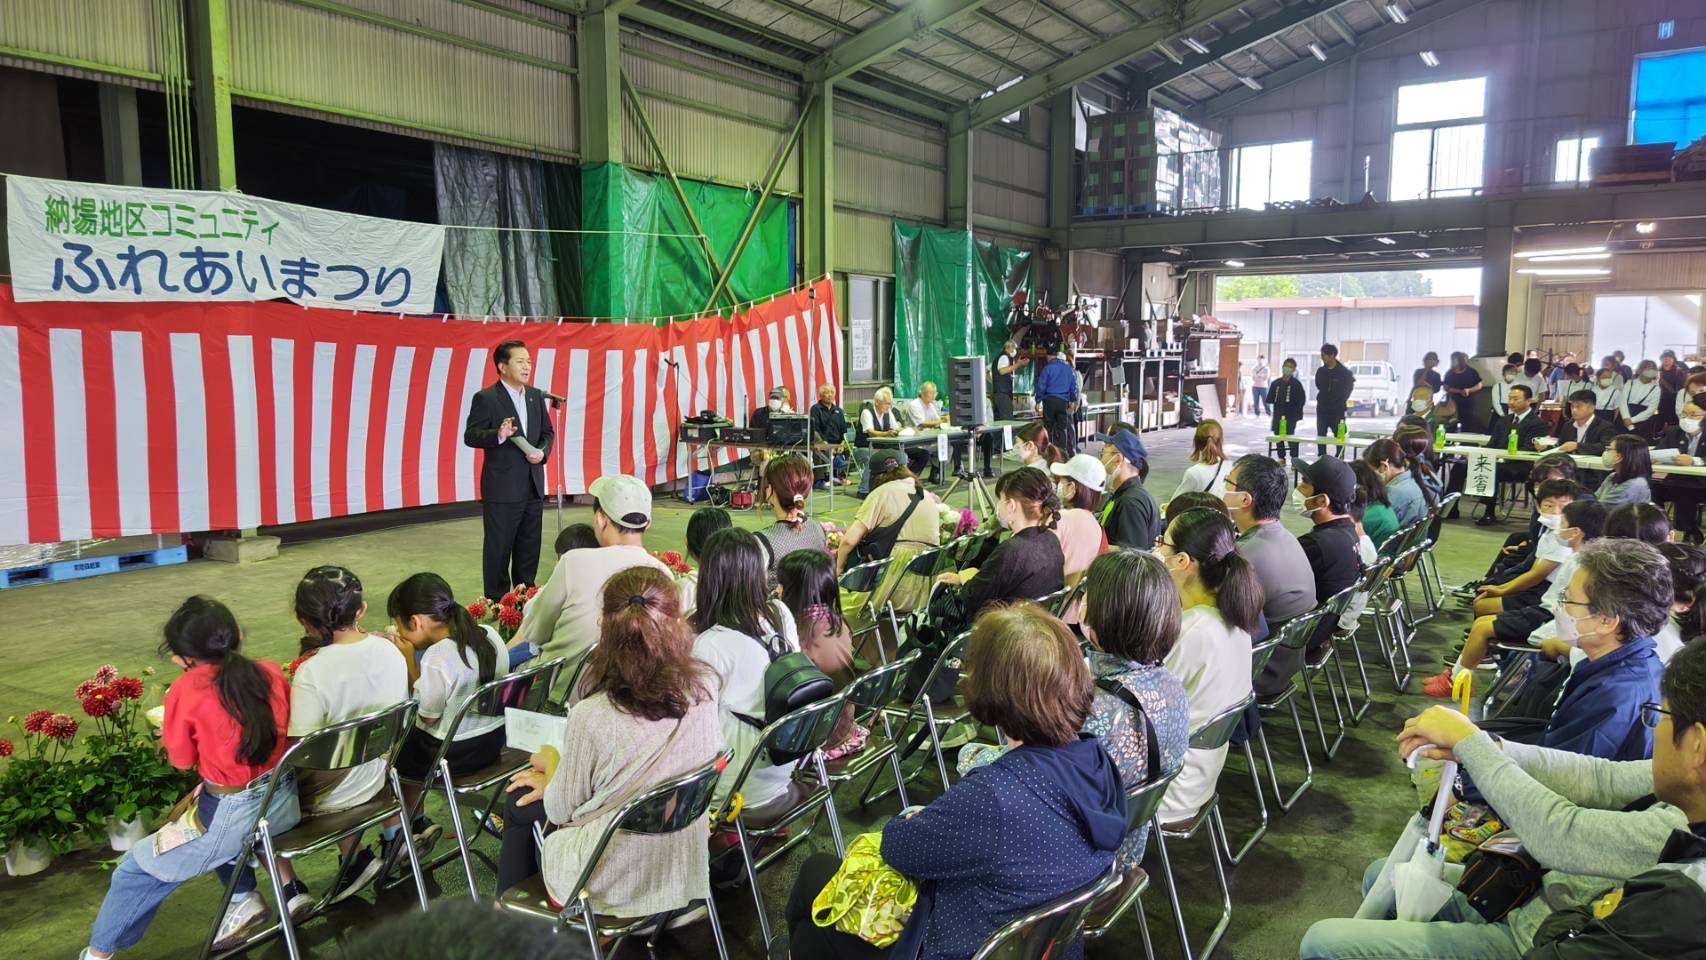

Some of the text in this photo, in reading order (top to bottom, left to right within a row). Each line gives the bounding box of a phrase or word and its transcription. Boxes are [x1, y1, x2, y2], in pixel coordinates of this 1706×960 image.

[45, 195, 279, 245] 納場地区コミュニティ
[52, 242, 411, 307] ふれあいまつり
[1473, 454, 1492, 495] 来賓
